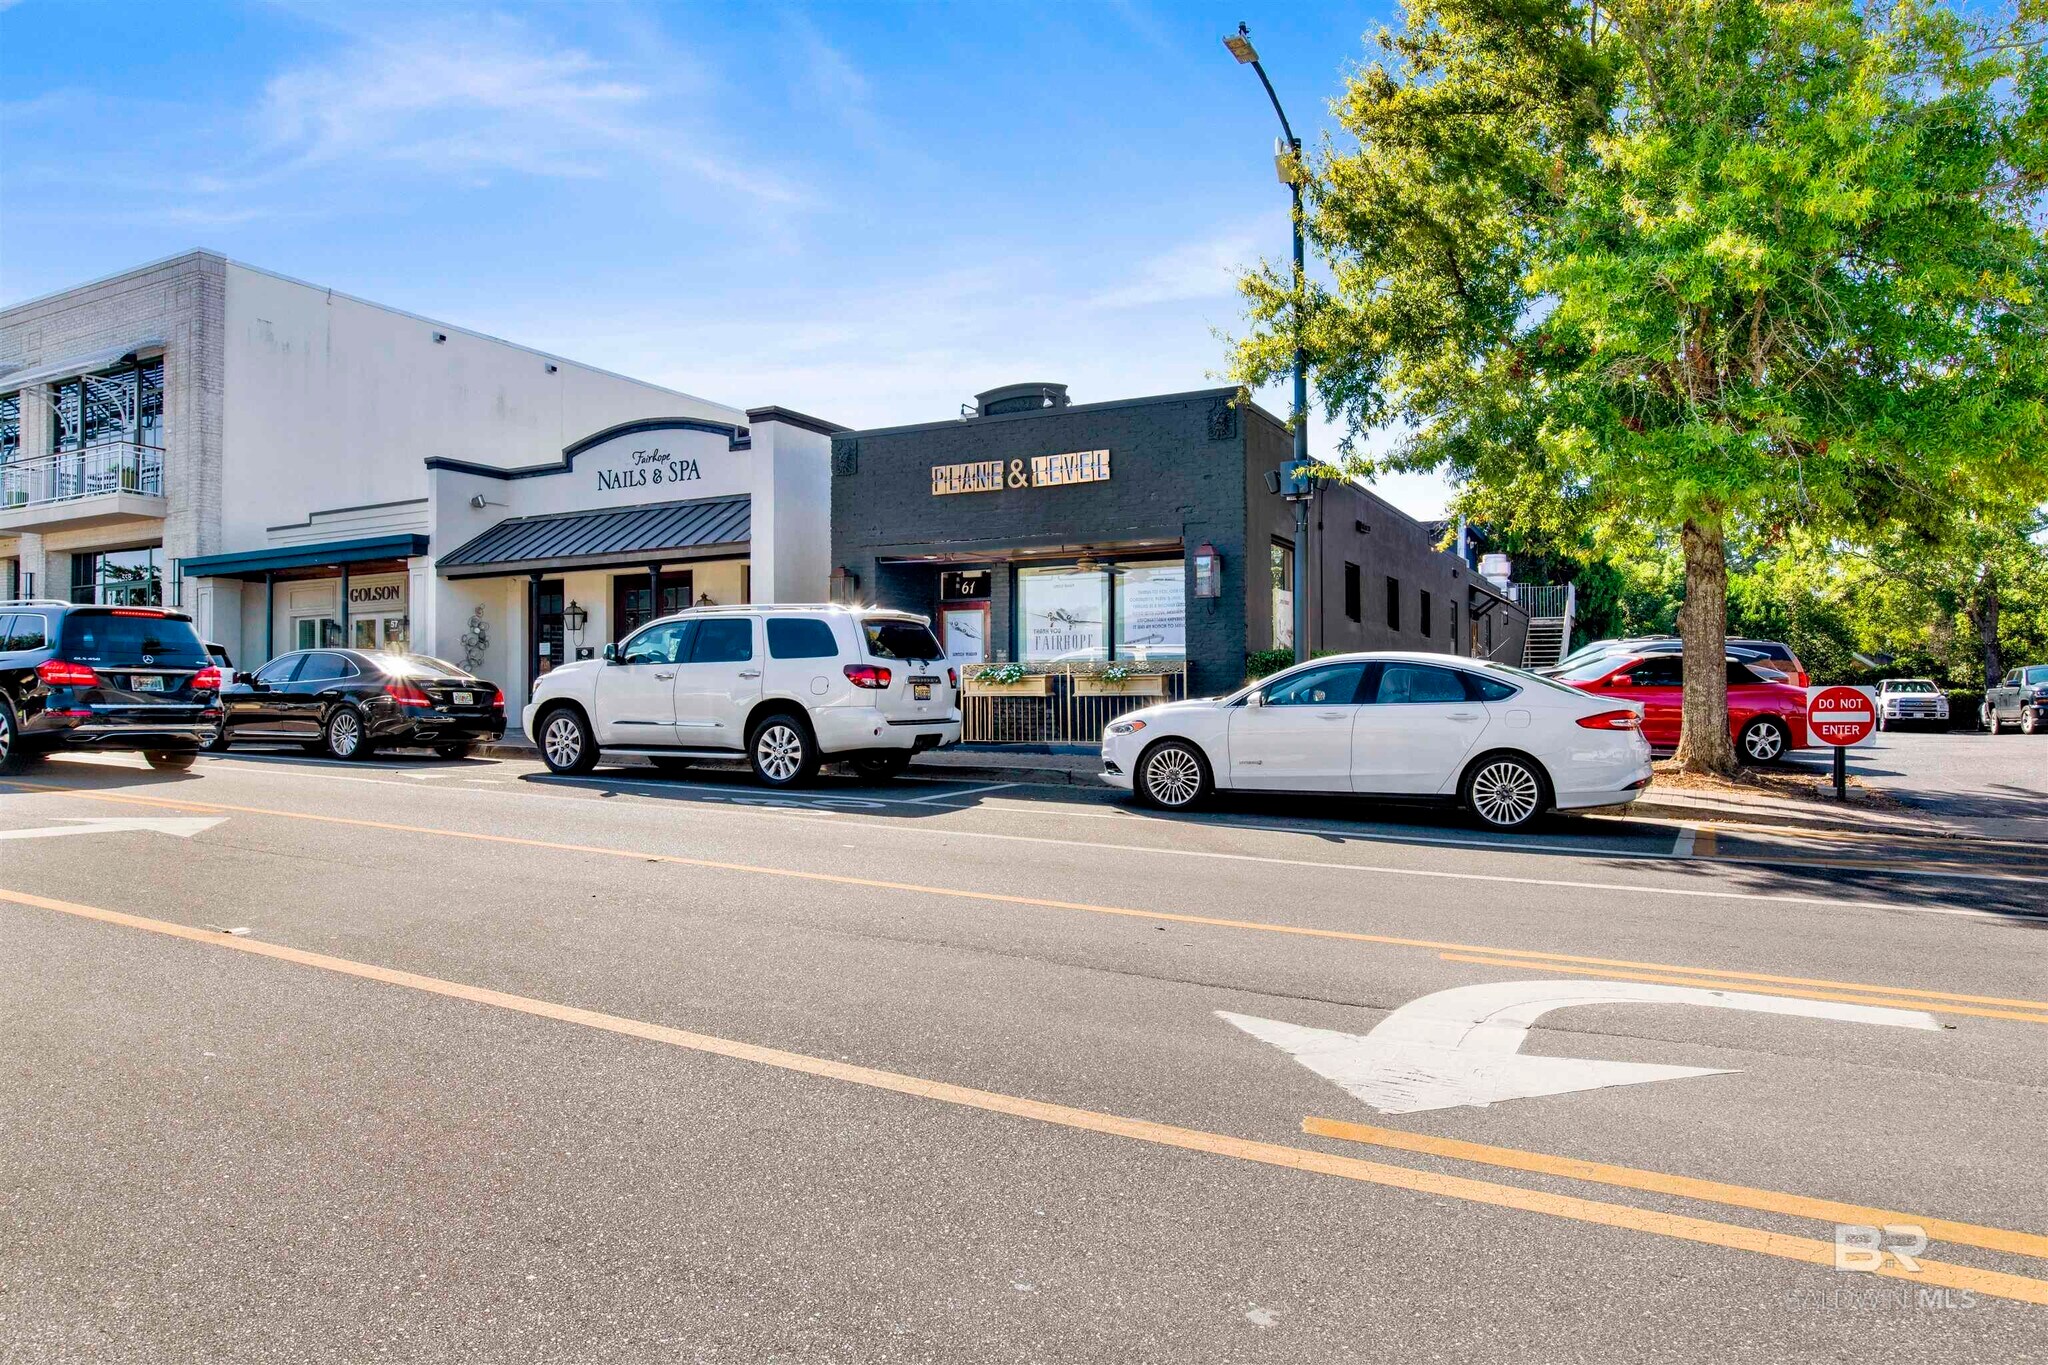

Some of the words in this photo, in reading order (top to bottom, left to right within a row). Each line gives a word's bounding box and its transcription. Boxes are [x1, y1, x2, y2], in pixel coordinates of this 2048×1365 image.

[632, 448, 671, 466] Fairhope
[597, 468, 647, 491] NAILS
[652, 468, 663, 484] &
[668, 458, 702, 482] SPA
[932, 460, 1004, 495] PLANE
[1007, 458, 1029, 489] &
[1031, 449, 1110, 487] LEVEL
[350, 585, 400, 603] GOLSON
[961, 580, 976, 595] 61
[390, 620, 399, 628] 57
[1034, 633, 1094, 651] FAIRHOPE
[1819, 698, 1835, 709] DO
[1840, 698, 1863, 709] NOT
[1822, 724, 1860, 735] ENTER
